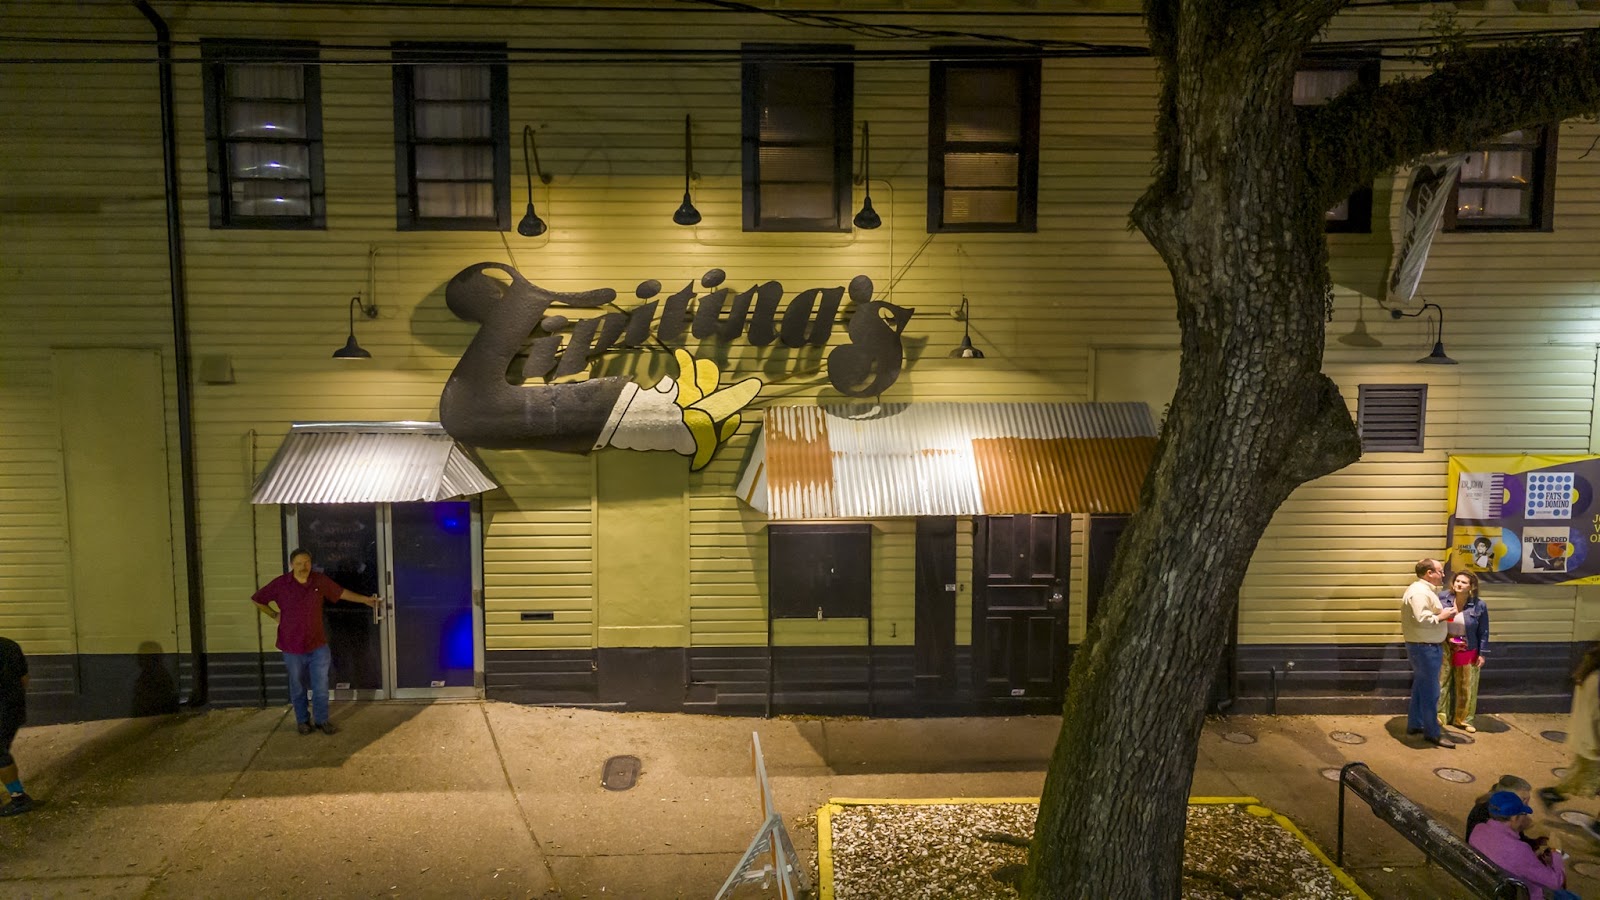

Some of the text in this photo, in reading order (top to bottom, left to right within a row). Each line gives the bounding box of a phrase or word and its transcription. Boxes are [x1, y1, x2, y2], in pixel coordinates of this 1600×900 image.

[440, 262, 915, 452] Tipitina's
[1545, 492, 1562, 500] FATS
[1545, 500, 1570, 508] DOMINO
